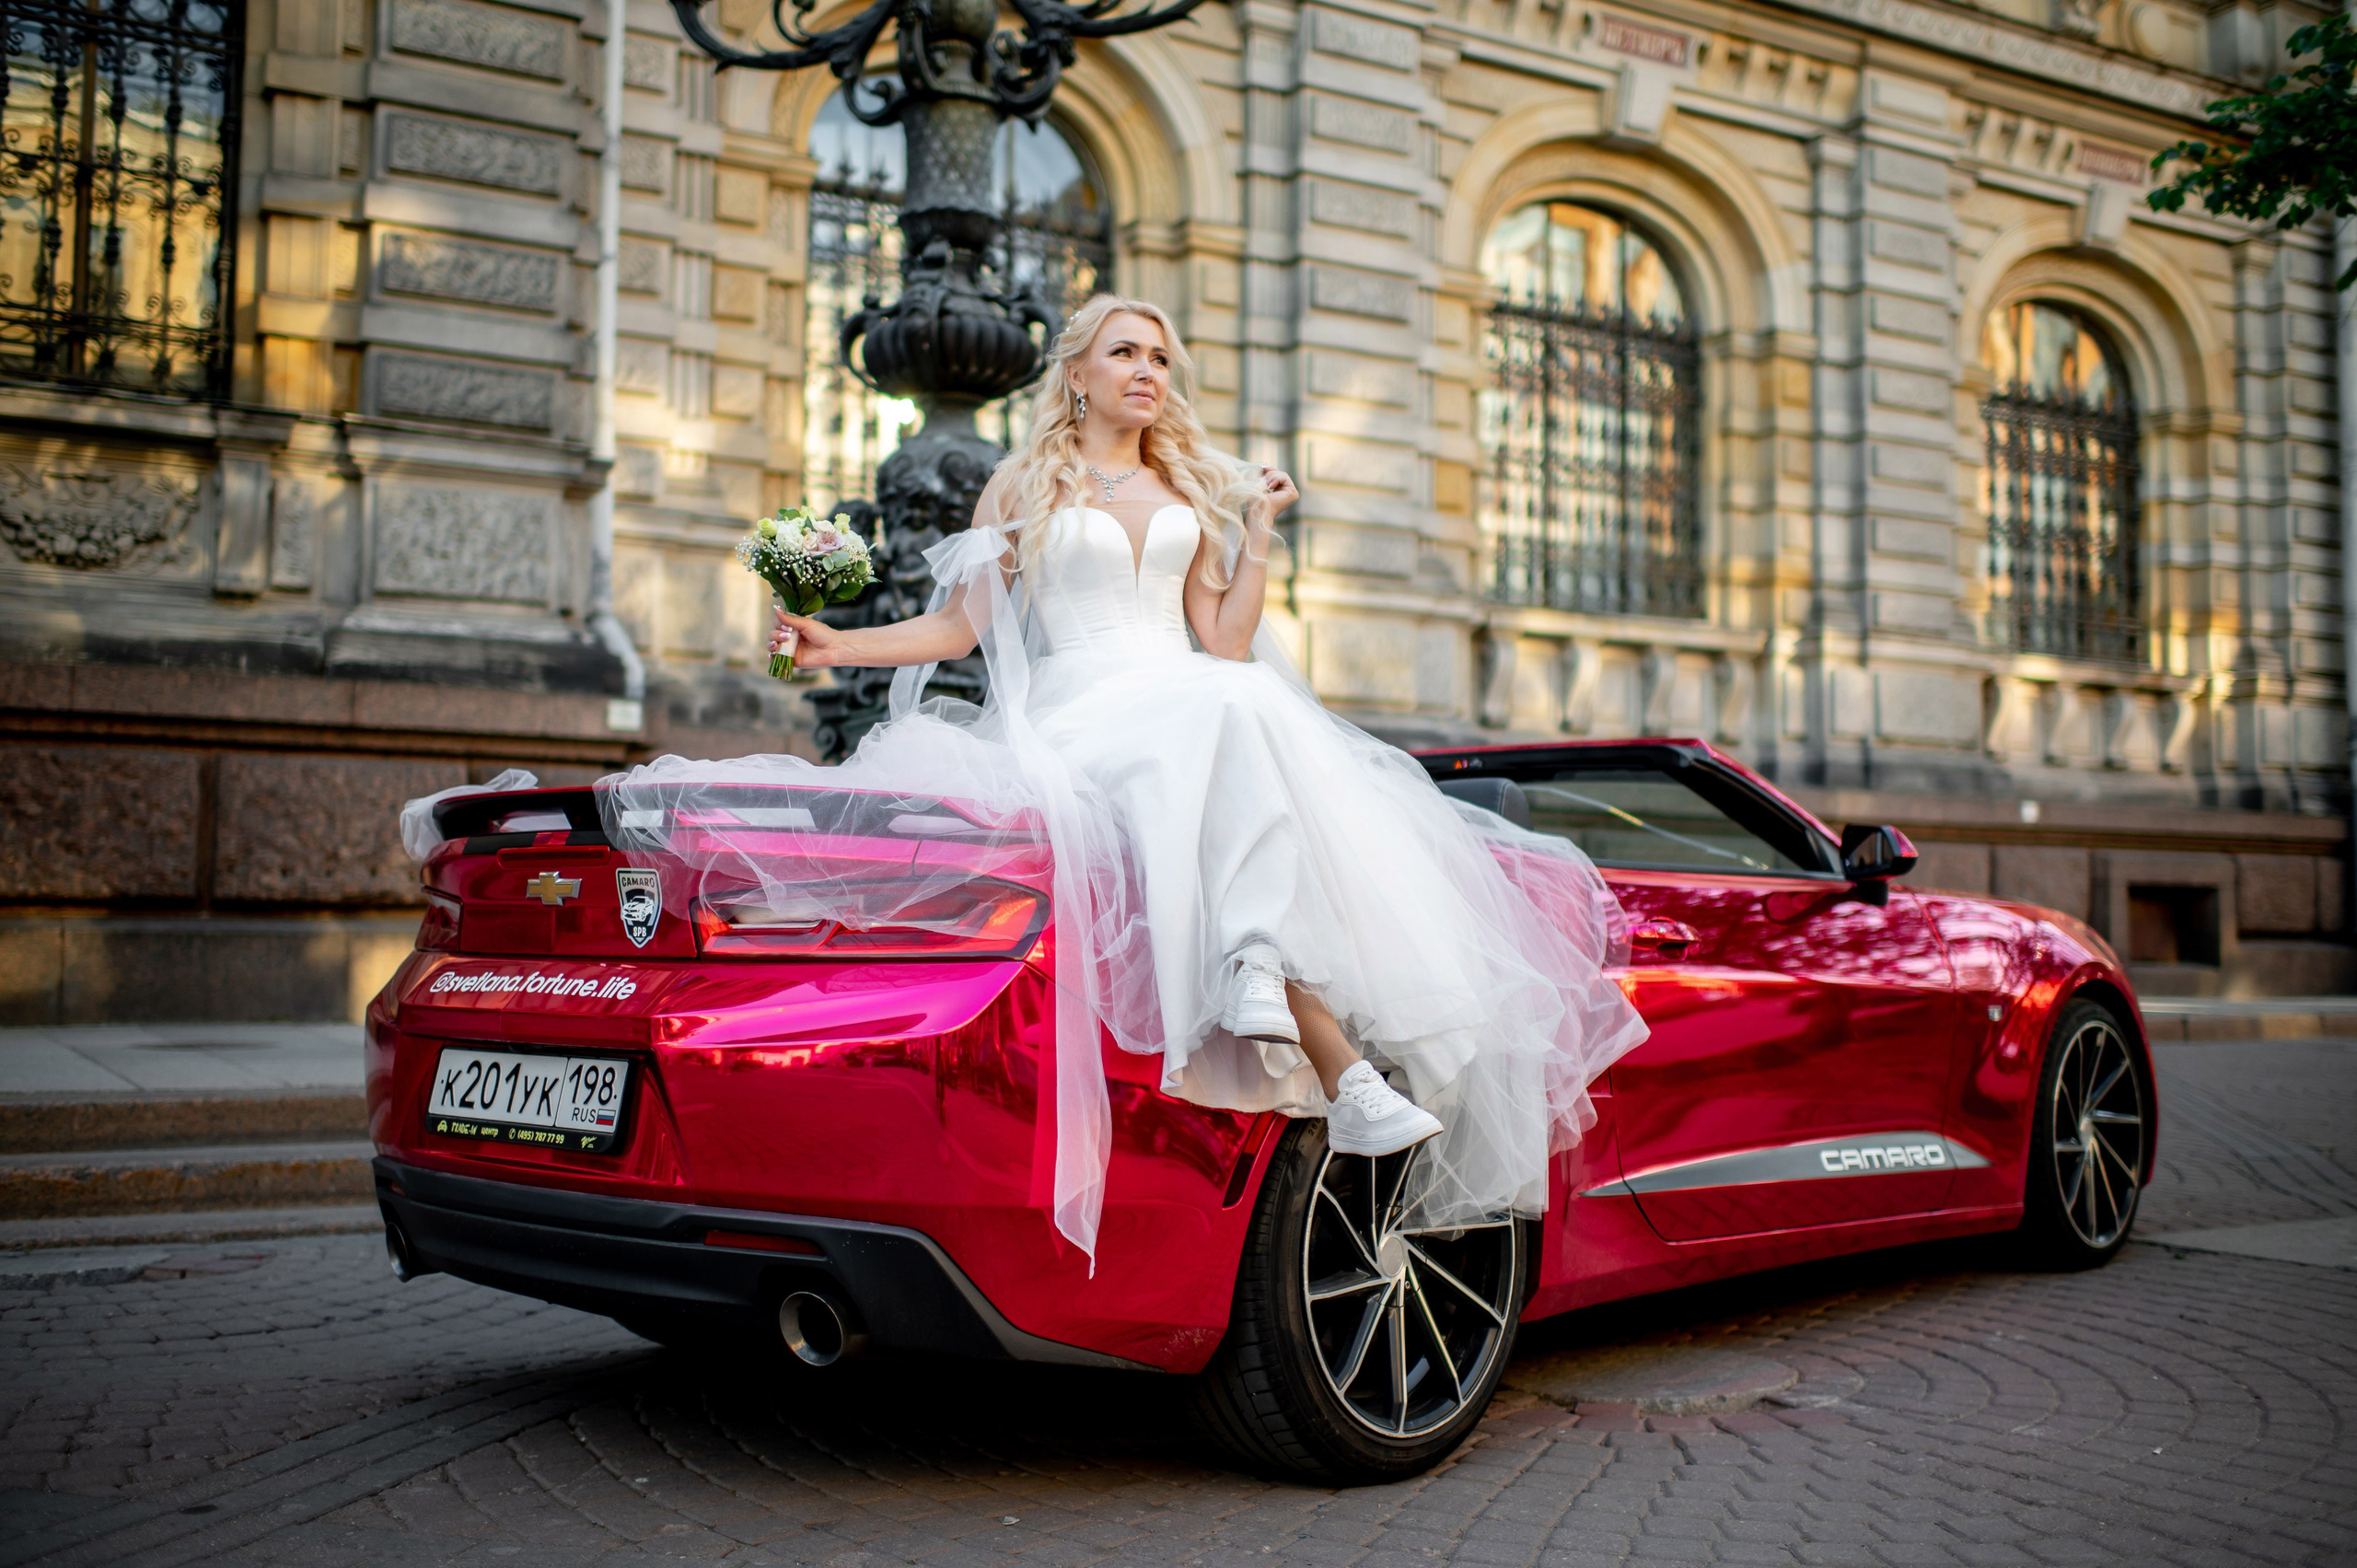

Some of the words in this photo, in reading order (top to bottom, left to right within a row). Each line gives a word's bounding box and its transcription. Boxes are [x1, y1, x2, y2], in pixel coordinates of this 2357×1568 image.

[621, 877, 656, 888] CAMARO
[633, 926, 647, 937] SPB
[569, 1063, 617, 1106] 198
[572, 1107, 597, 1123] RUS
[481, 1127, 499, 1137] центр
[517, 1130, 534, 1141] (495)
[535, 1132, 547, 1142] 787
[547, 1132, 555, 1143] 77
[556, 1133, 565, 1144] 99
[1820, 1144, 1945, 1171] CAMARO
